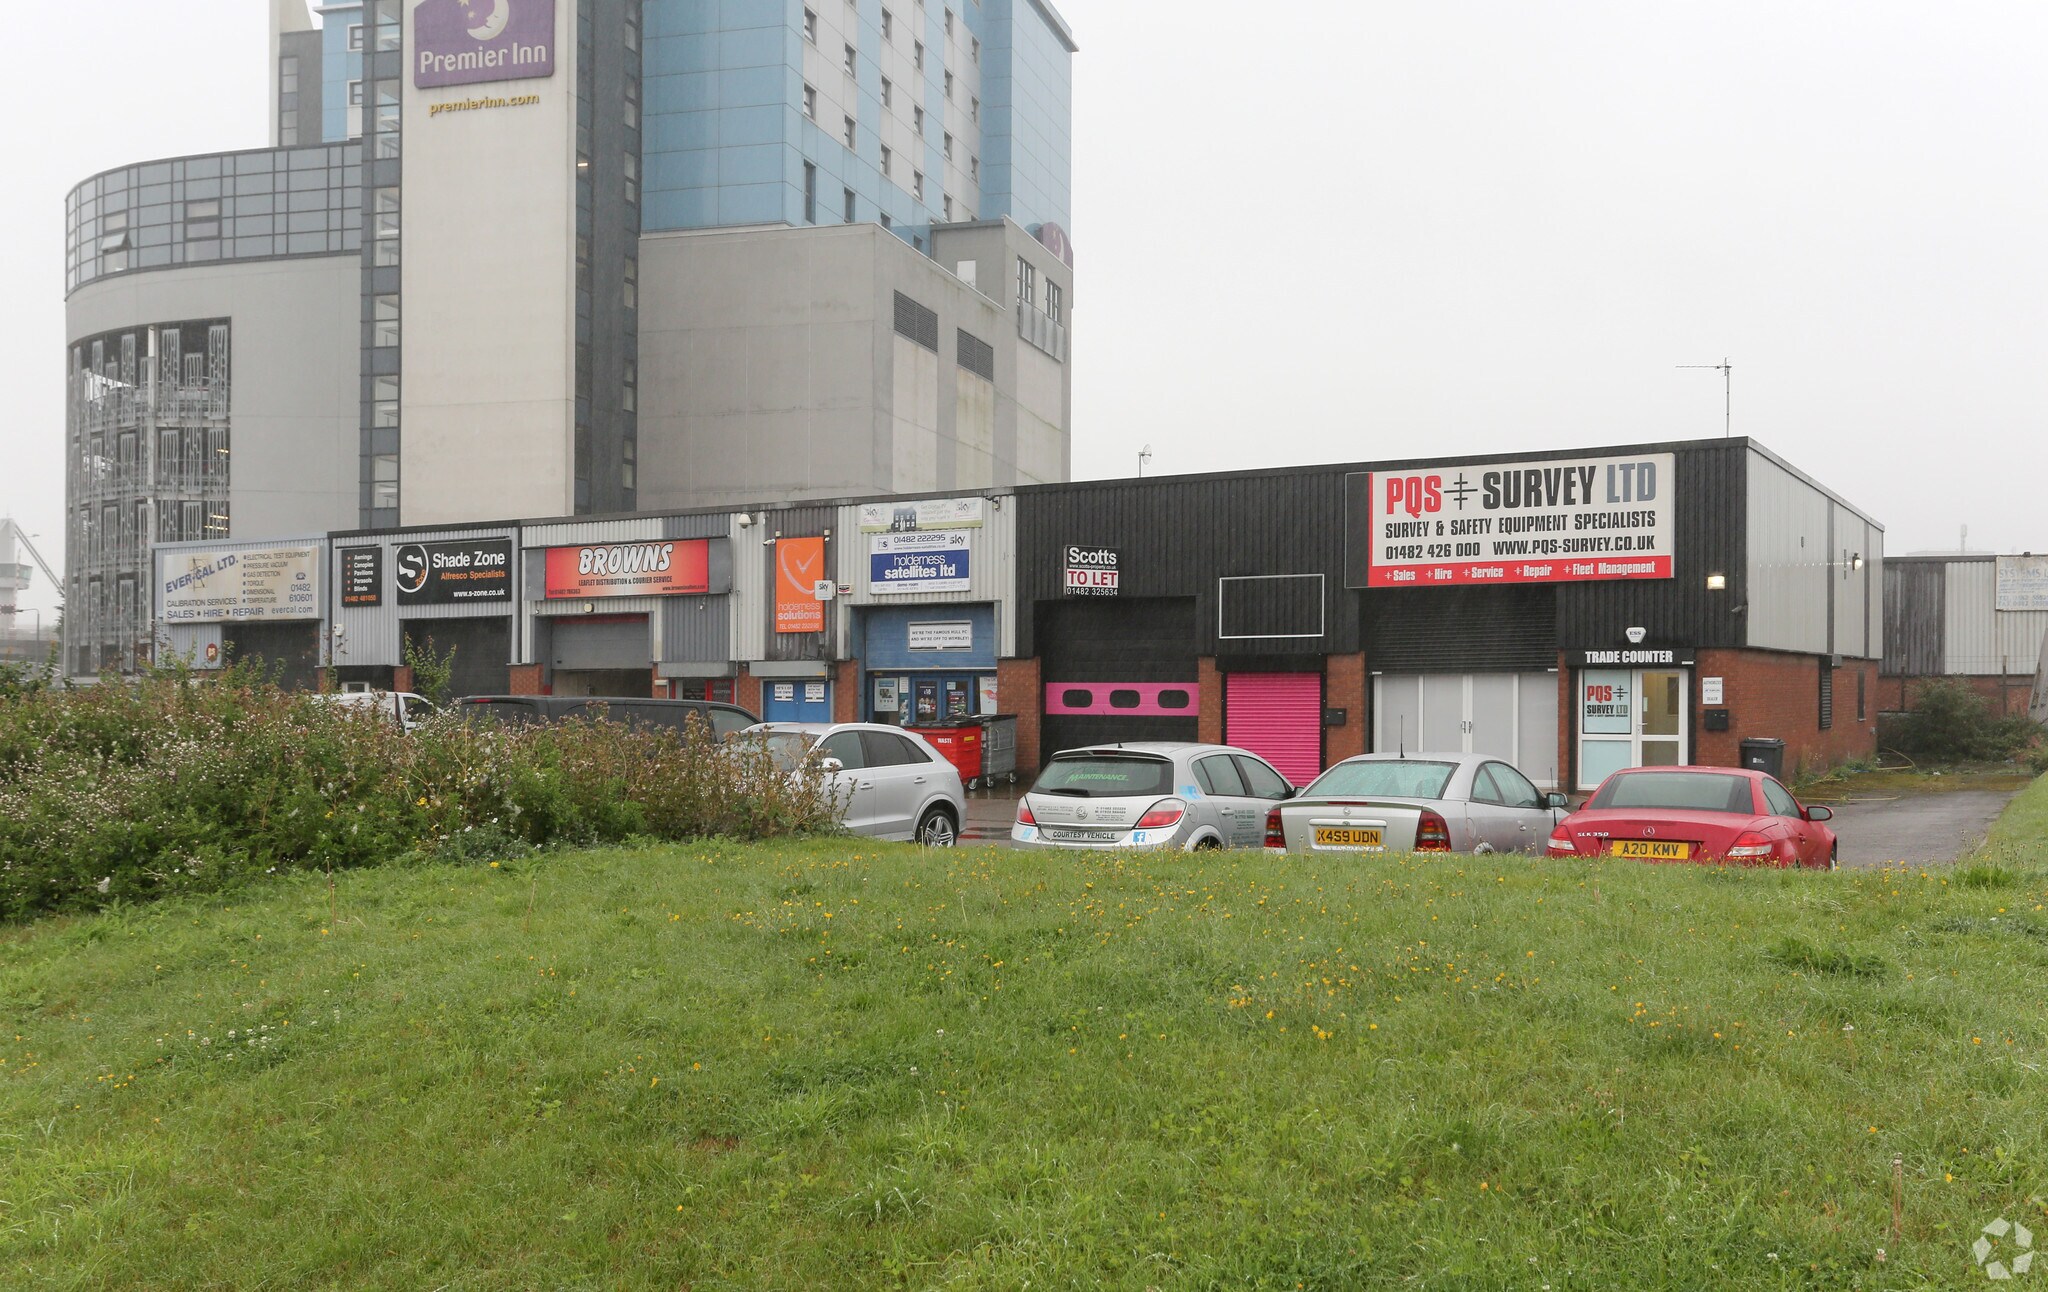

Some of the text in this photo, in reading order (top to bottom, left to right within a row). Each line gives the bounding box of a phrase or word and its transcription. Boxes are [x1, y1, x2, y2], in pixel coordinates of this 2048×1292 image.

[420, 42, 546, 73] Premier Inn
[429, 94, 540, 117] premierinn.com
[1386, 462, 1656, 519] PQS SURVEY LTD
[1385, 510, 1656, 539] SURVEY & SAFETY EQUIPMENT SPECIALISTS
[894, 534, 945, 544] 01482 222295
[950, 534, 965, 546] sky
[1385, 535, 1655, 559] 01482 426 000 WWW.PQS-SURVEY.CO.UK
[285, 551, 310, 559] EQUIPMENT
[432, 551, 506, 569] Shade Zone
[578, 543, 673, 576] BROWNS
[894, 554, 946, 566] holderness
[1068, 547, 1117, 564] Scotts
[165, 554, 239, 594] EVER-CAL LTD.
[440, 569, 506, 581] Alfresco Specialists
[884, 564, 956, 579] satellites ltd
[1393, 561, 1656, 581] Sales Hire Service Repair Fleet Management
[579, 578, 595, 587] LEAFLET
[596, 577, 628, 586] DISTRIBUTION
[633, 576, 652, 585] COURIER
[653, 575, 672, 584] SERVICE
[1068, 570, 1117, 586] TO LET
[290, 583, 311, 592] 01482
[819, 582, 829, 591] sky
[1066, 587, 1118, 596] 01482 325634
[289, 593, 313, 603] 610601
[453, 588, 505, 598] www.s-zone.co.uk
[167, 597, 237, 608] CALIBRATION SERVICES
[778, 602, 820, 610] holderness
[167, 607, 264, 619] SALES HIRE REPAIR
[271, 605, 313, 614] evercal.com
[778, 610, 820, 620] solutions
[1585, 650, 1673, 663] TRADE COUNTER
[1586, 685, 1612, 703] PQS
[1586, 704, 1629, 714] SURVEY LTD
[1052, 830, 1115, 840] COURTESY VEHICLE
[1353, 830, 1379, 843] UDN
[1622, 843, 1680, 856] A20 KMV
